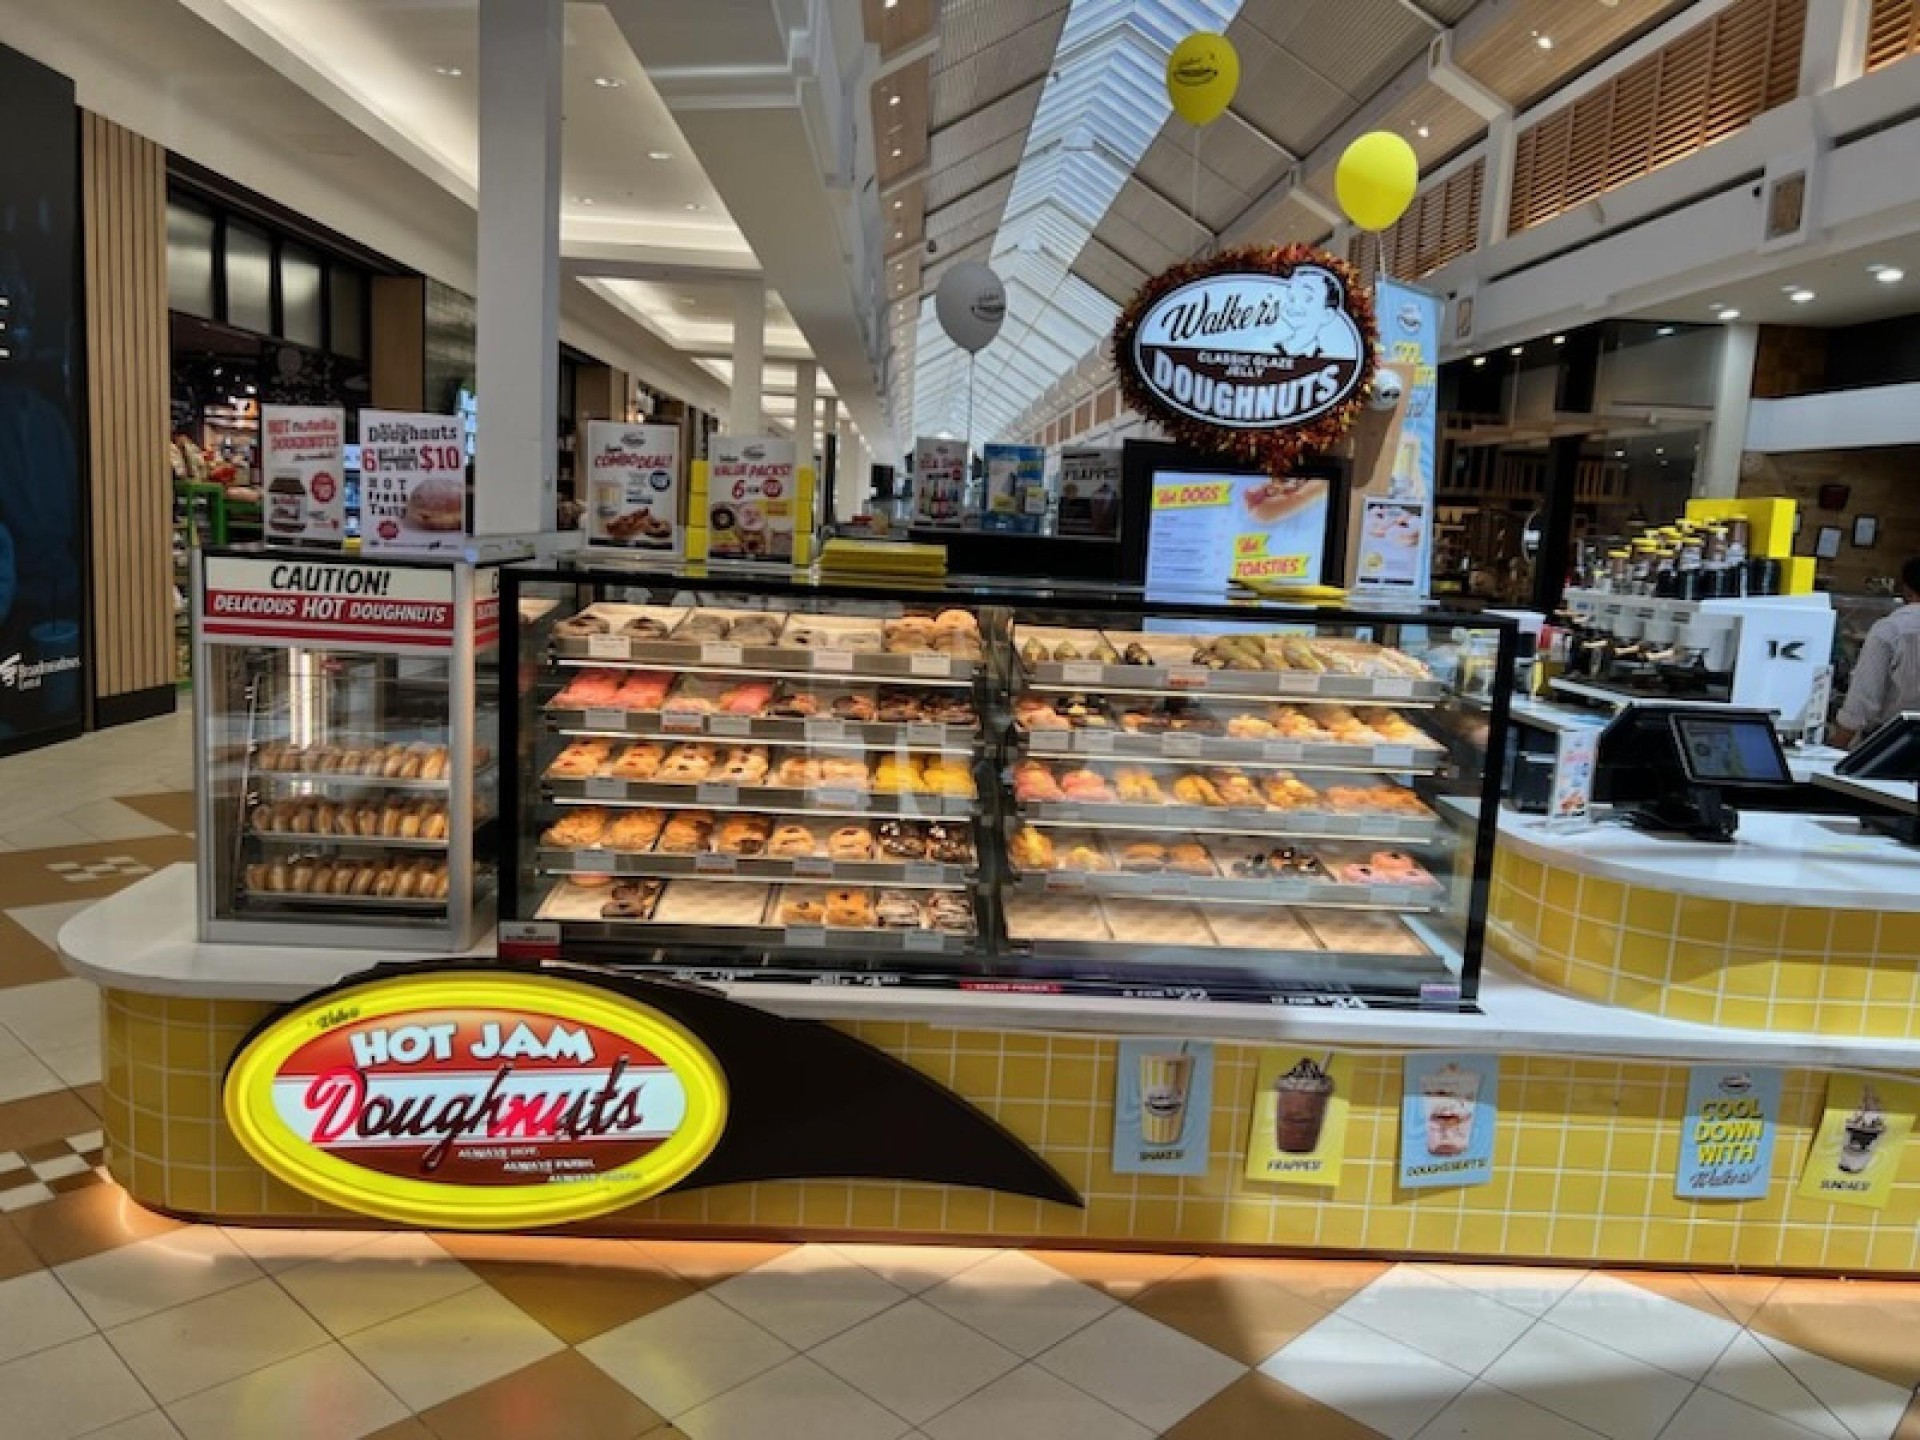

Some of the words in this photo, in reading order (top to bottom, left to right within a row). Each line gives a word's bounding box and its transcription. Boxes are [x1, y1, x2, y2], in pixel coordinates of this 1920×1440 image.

[1161, 290, 1280, 341] Walker's
[1154, 349, 1340, 420] DOUGHNUTS
[362, 449, 378, 472] 6
[420, 445, 460, 473] $10
[594, 453, 637, 469] COMBO
[731, 479, 746, 499] 6
[1181, 486, 1221, 503] DOGS
[270, 563, 392, 596] CAUTION!
[214, 593, 296, 615] DELICIOUS
[302, 597, 346, 619] HOT
[348, 602, 447, 623] DOUGHNUTS
[350, 1022, 457, 1068] HOT
[469, 1021, 595, 1064] JAM
[304, 1054, 646, 1172] Doughnuts
[1702, 1100, 1765, 1121] COOL
[1695, 1120, 1764, 1143] DOWN
[1698, 1144, 1757, 1167] WITH
